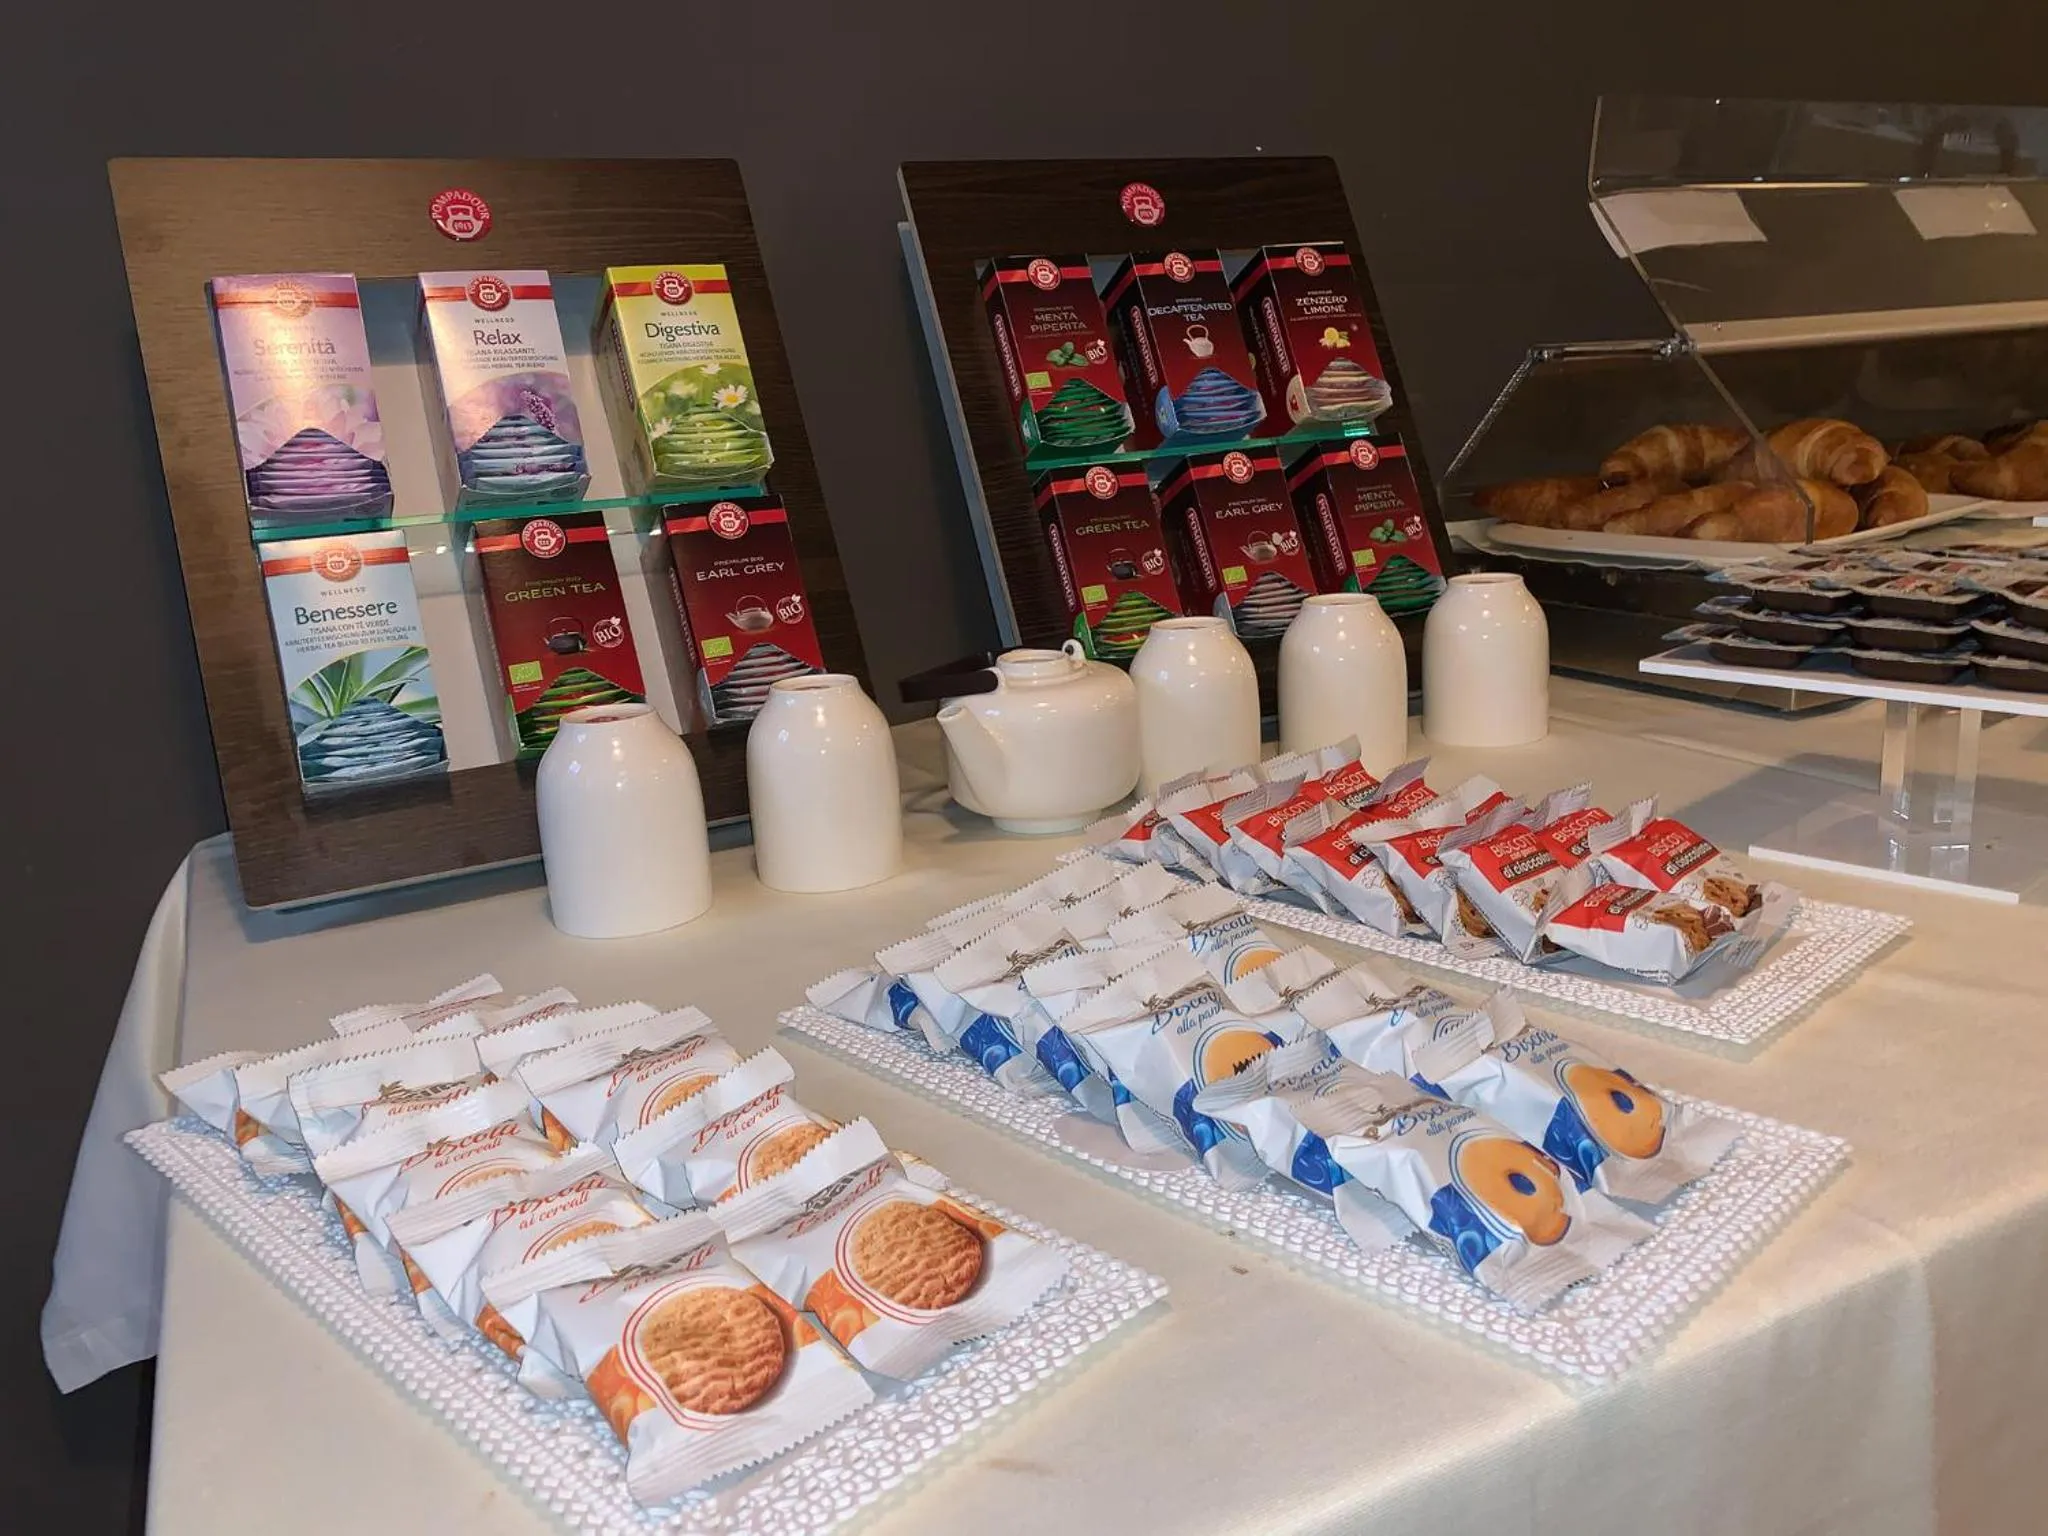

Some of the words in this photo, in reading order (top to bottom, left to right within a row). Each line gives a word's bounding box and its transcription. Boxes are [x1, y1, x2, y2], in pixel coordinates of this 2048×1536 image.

[431, 190, 490, 219] POMPADOUR
[1296, 295, 1348, 306] ZENZERO
[1035, 312, 1078, 322] MENTA
[1184, 313, 1205, 321] TEA
[1304, 305, 1345, 314] LIMONE
[645, 321, 720, 342] Digestiva
[1031, 322, 1087, 333] PIPERITA
[473, 329, 522, 345] Relax
[253, 337, 337, 357] Serenità
[1087, 346, 1105, 360] BIO
[1358, 491, 1395, 502] MENTA
[1215, 508, 1250, 519] EARL
[1252, 503, 1283, 514] GREY
[1354, 499, 1404, 512] PIPERITA
[1075, 522, 1121, 535] GREEN
[1124, 519, 1149, 530] TEA
[1280, 537, 1298, 552] BIO
[1143, 555, 1163, 570] BIO
[696, 568, 740, 581] EARL
[744, 562, 785, 575] GREY
[504, 587, 566, 602] GREEN
[570, 582, 606, 595] TEA
[294, 601, 398, 625] Benessere
[778, 602, 802, 620] BIO
[596, 624, 622, 643] BIO
[1503, 865, 1513, 879] di
[1176, 1019, 1197, 1035] alla
[725, 1126, 740, 1139] ai
[740, 1098, 780, 1132] cereali
[1426, 1122, 1446, 1137] alla
[1446, 1108, 1477, 1132] panna
[434, 1159, 450, 1170] ai
[453, 1138, 503, 1164] cereali
[519, 1217, 536, 1230] ai
[540, 1190, 590, 1224] cereali
